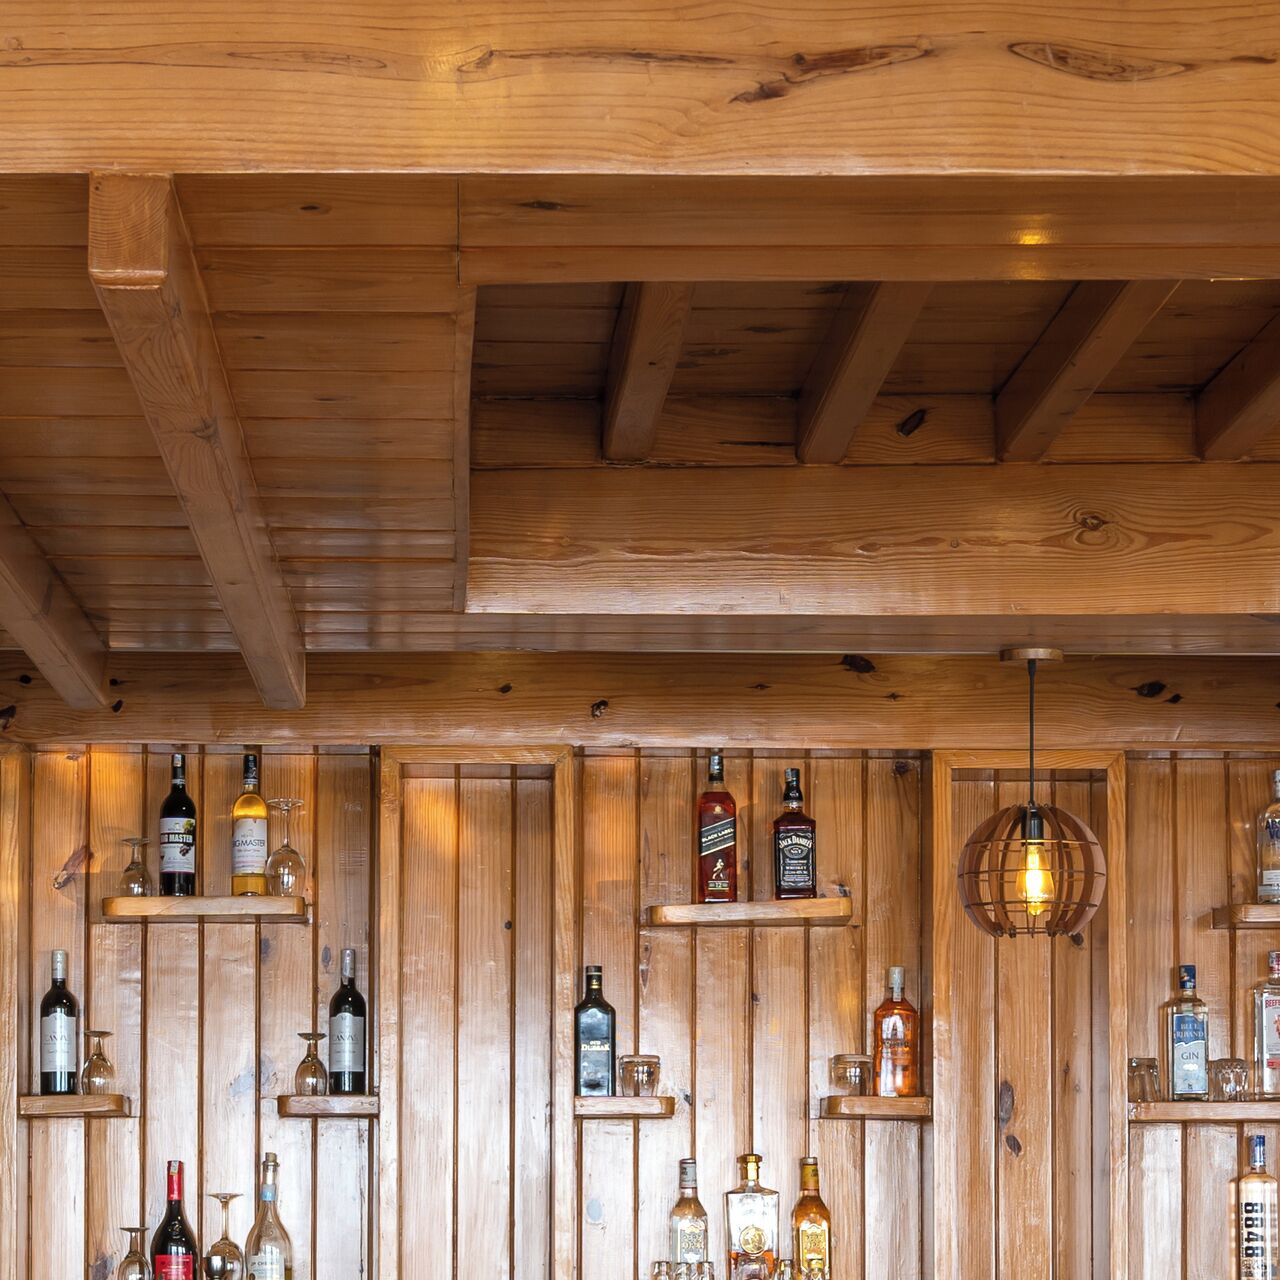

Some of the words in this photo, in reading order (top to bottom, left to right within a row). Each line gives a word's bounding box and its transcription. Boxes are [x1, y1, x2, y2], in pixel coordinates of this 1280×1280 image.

[702, 833, 718, 843] BLACK
[718, 827, 734, 837] LABEL
[779, 837, 792, 849] JACK
[1181, 1051, 1199, 1060] GIN
[1244, 1202, 1264, 1257] 8848
